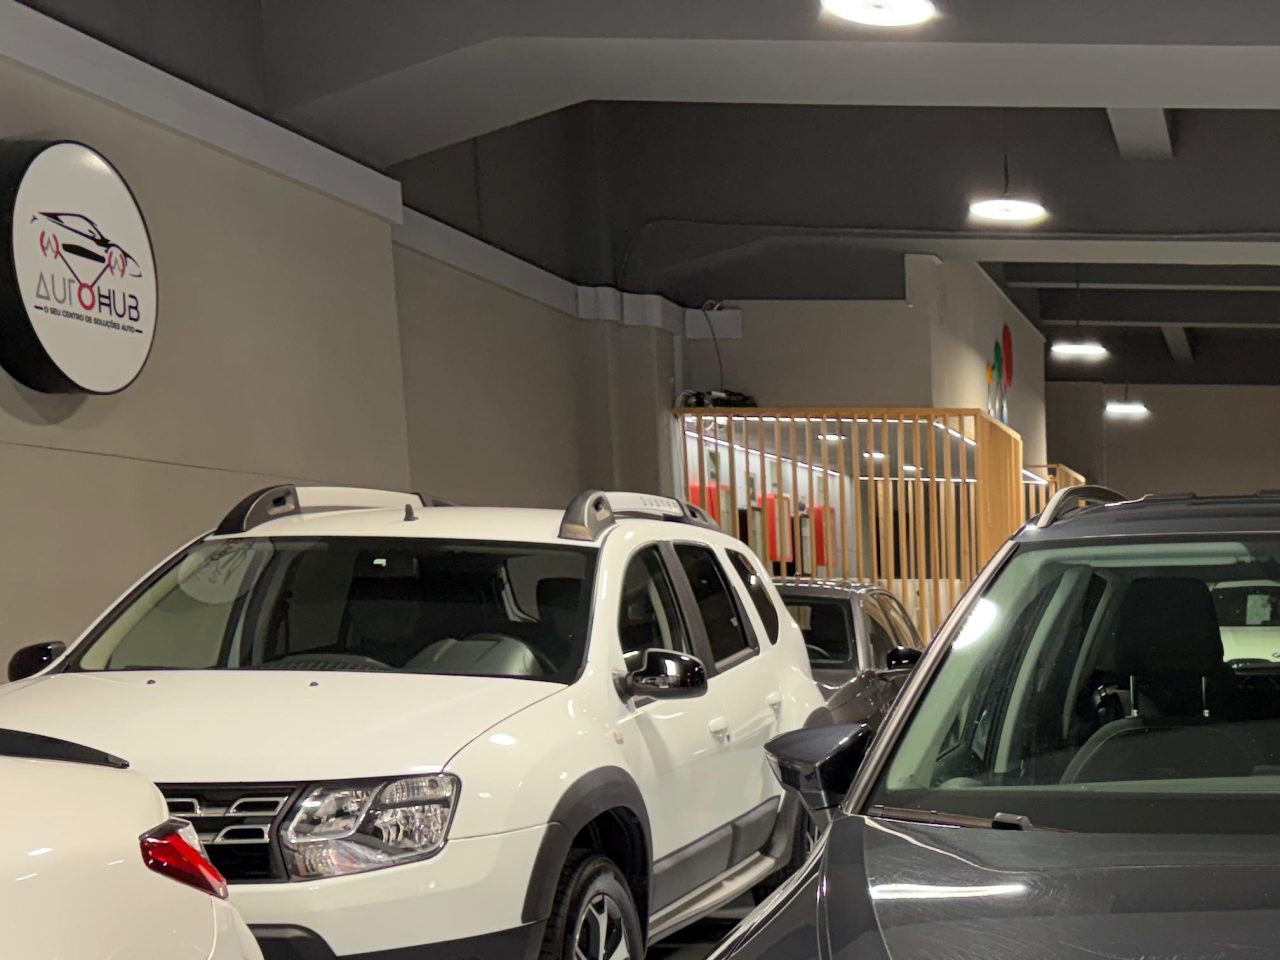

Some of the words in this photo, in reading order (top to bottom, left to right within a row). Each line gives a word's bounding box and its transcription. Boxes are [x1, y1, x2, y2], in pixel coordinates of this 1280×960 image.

[35, 271, 140, 322] AUTOHUB
[50, 307, 61, 316] SEU
[62, 310, 84, 321] CENTRO
[84, 315, 92, 323] DE
[121, 324, 135, 333] AUTO
